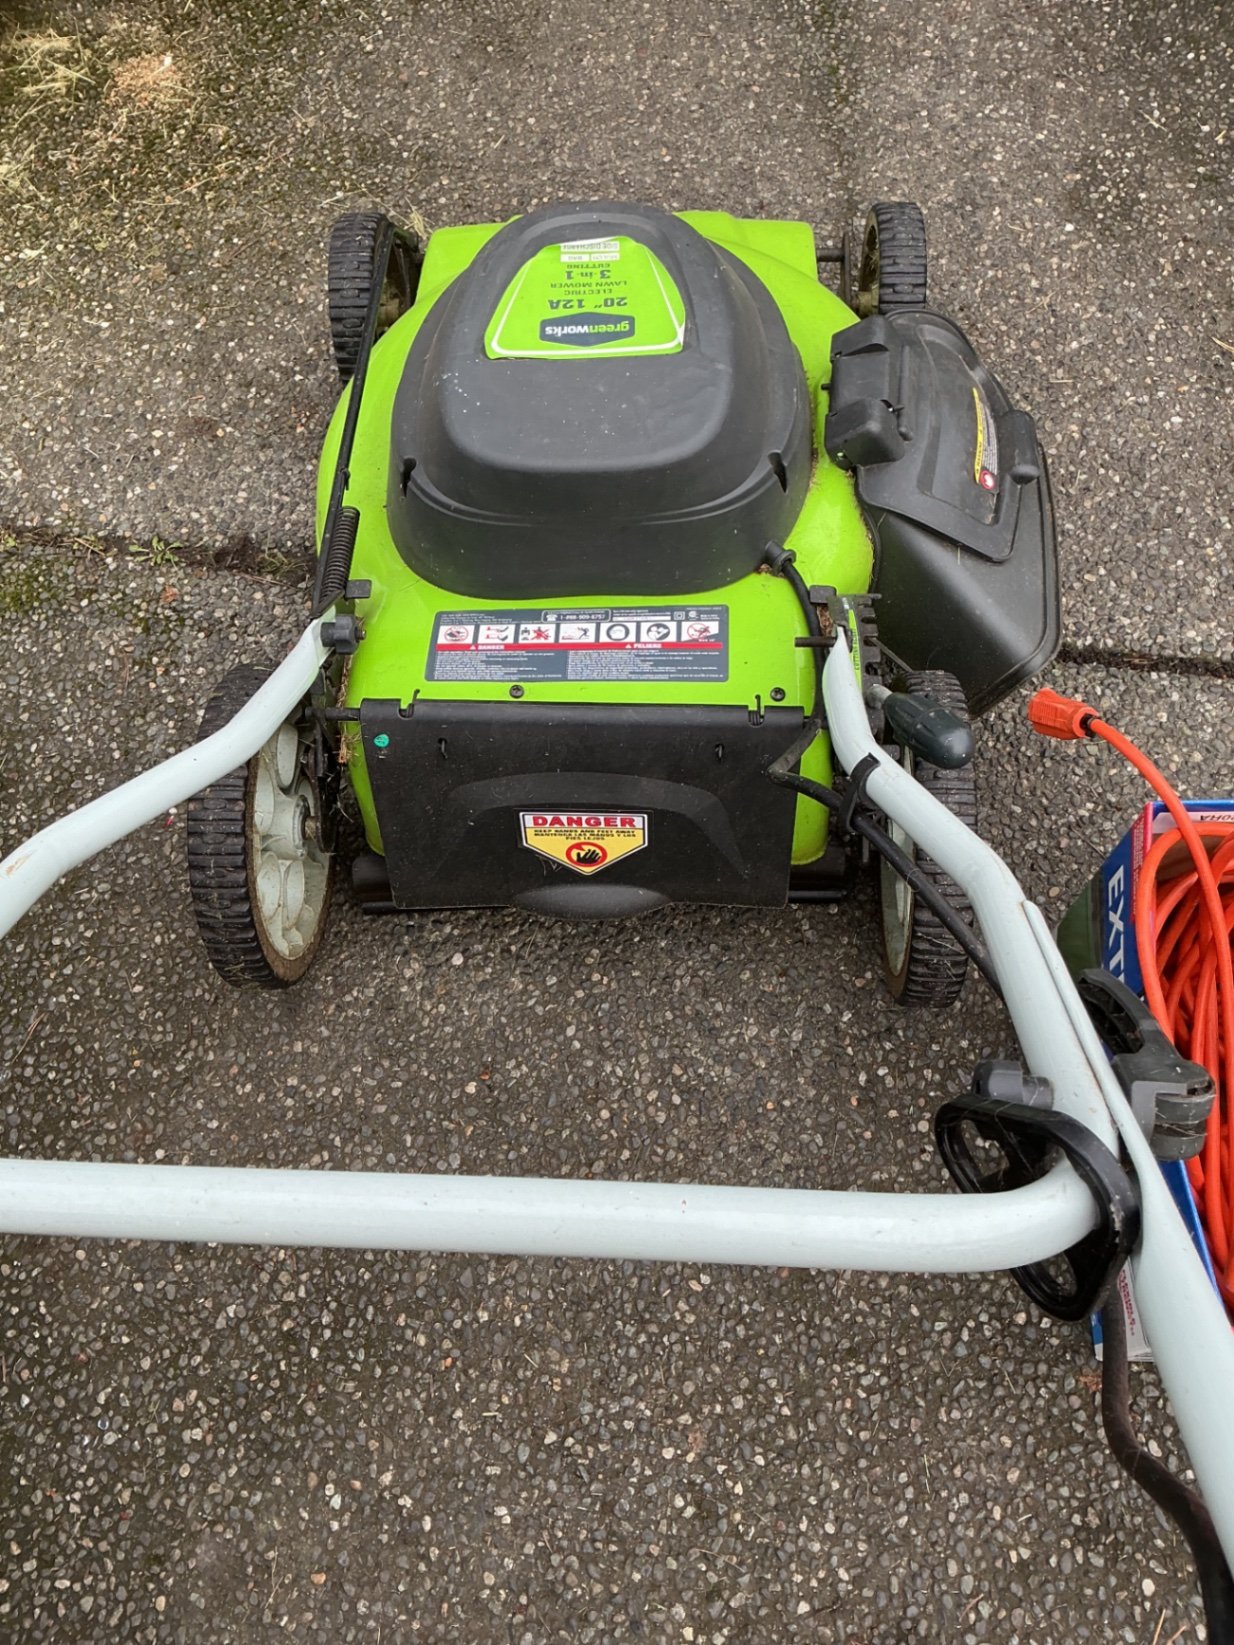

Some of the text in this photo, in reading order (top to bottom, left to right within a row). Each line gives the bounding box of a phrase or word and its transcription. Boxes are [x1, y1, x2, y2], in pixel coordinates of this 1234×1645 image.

[550, 280, 627, 289] LAWN MOWER
[564, 288, 613, 296] ELECTRIC
[548, 299, 585, 310] 12A
[545, 320, 630, 337] greenworks
[532, 816, 636, 827] DANGER
